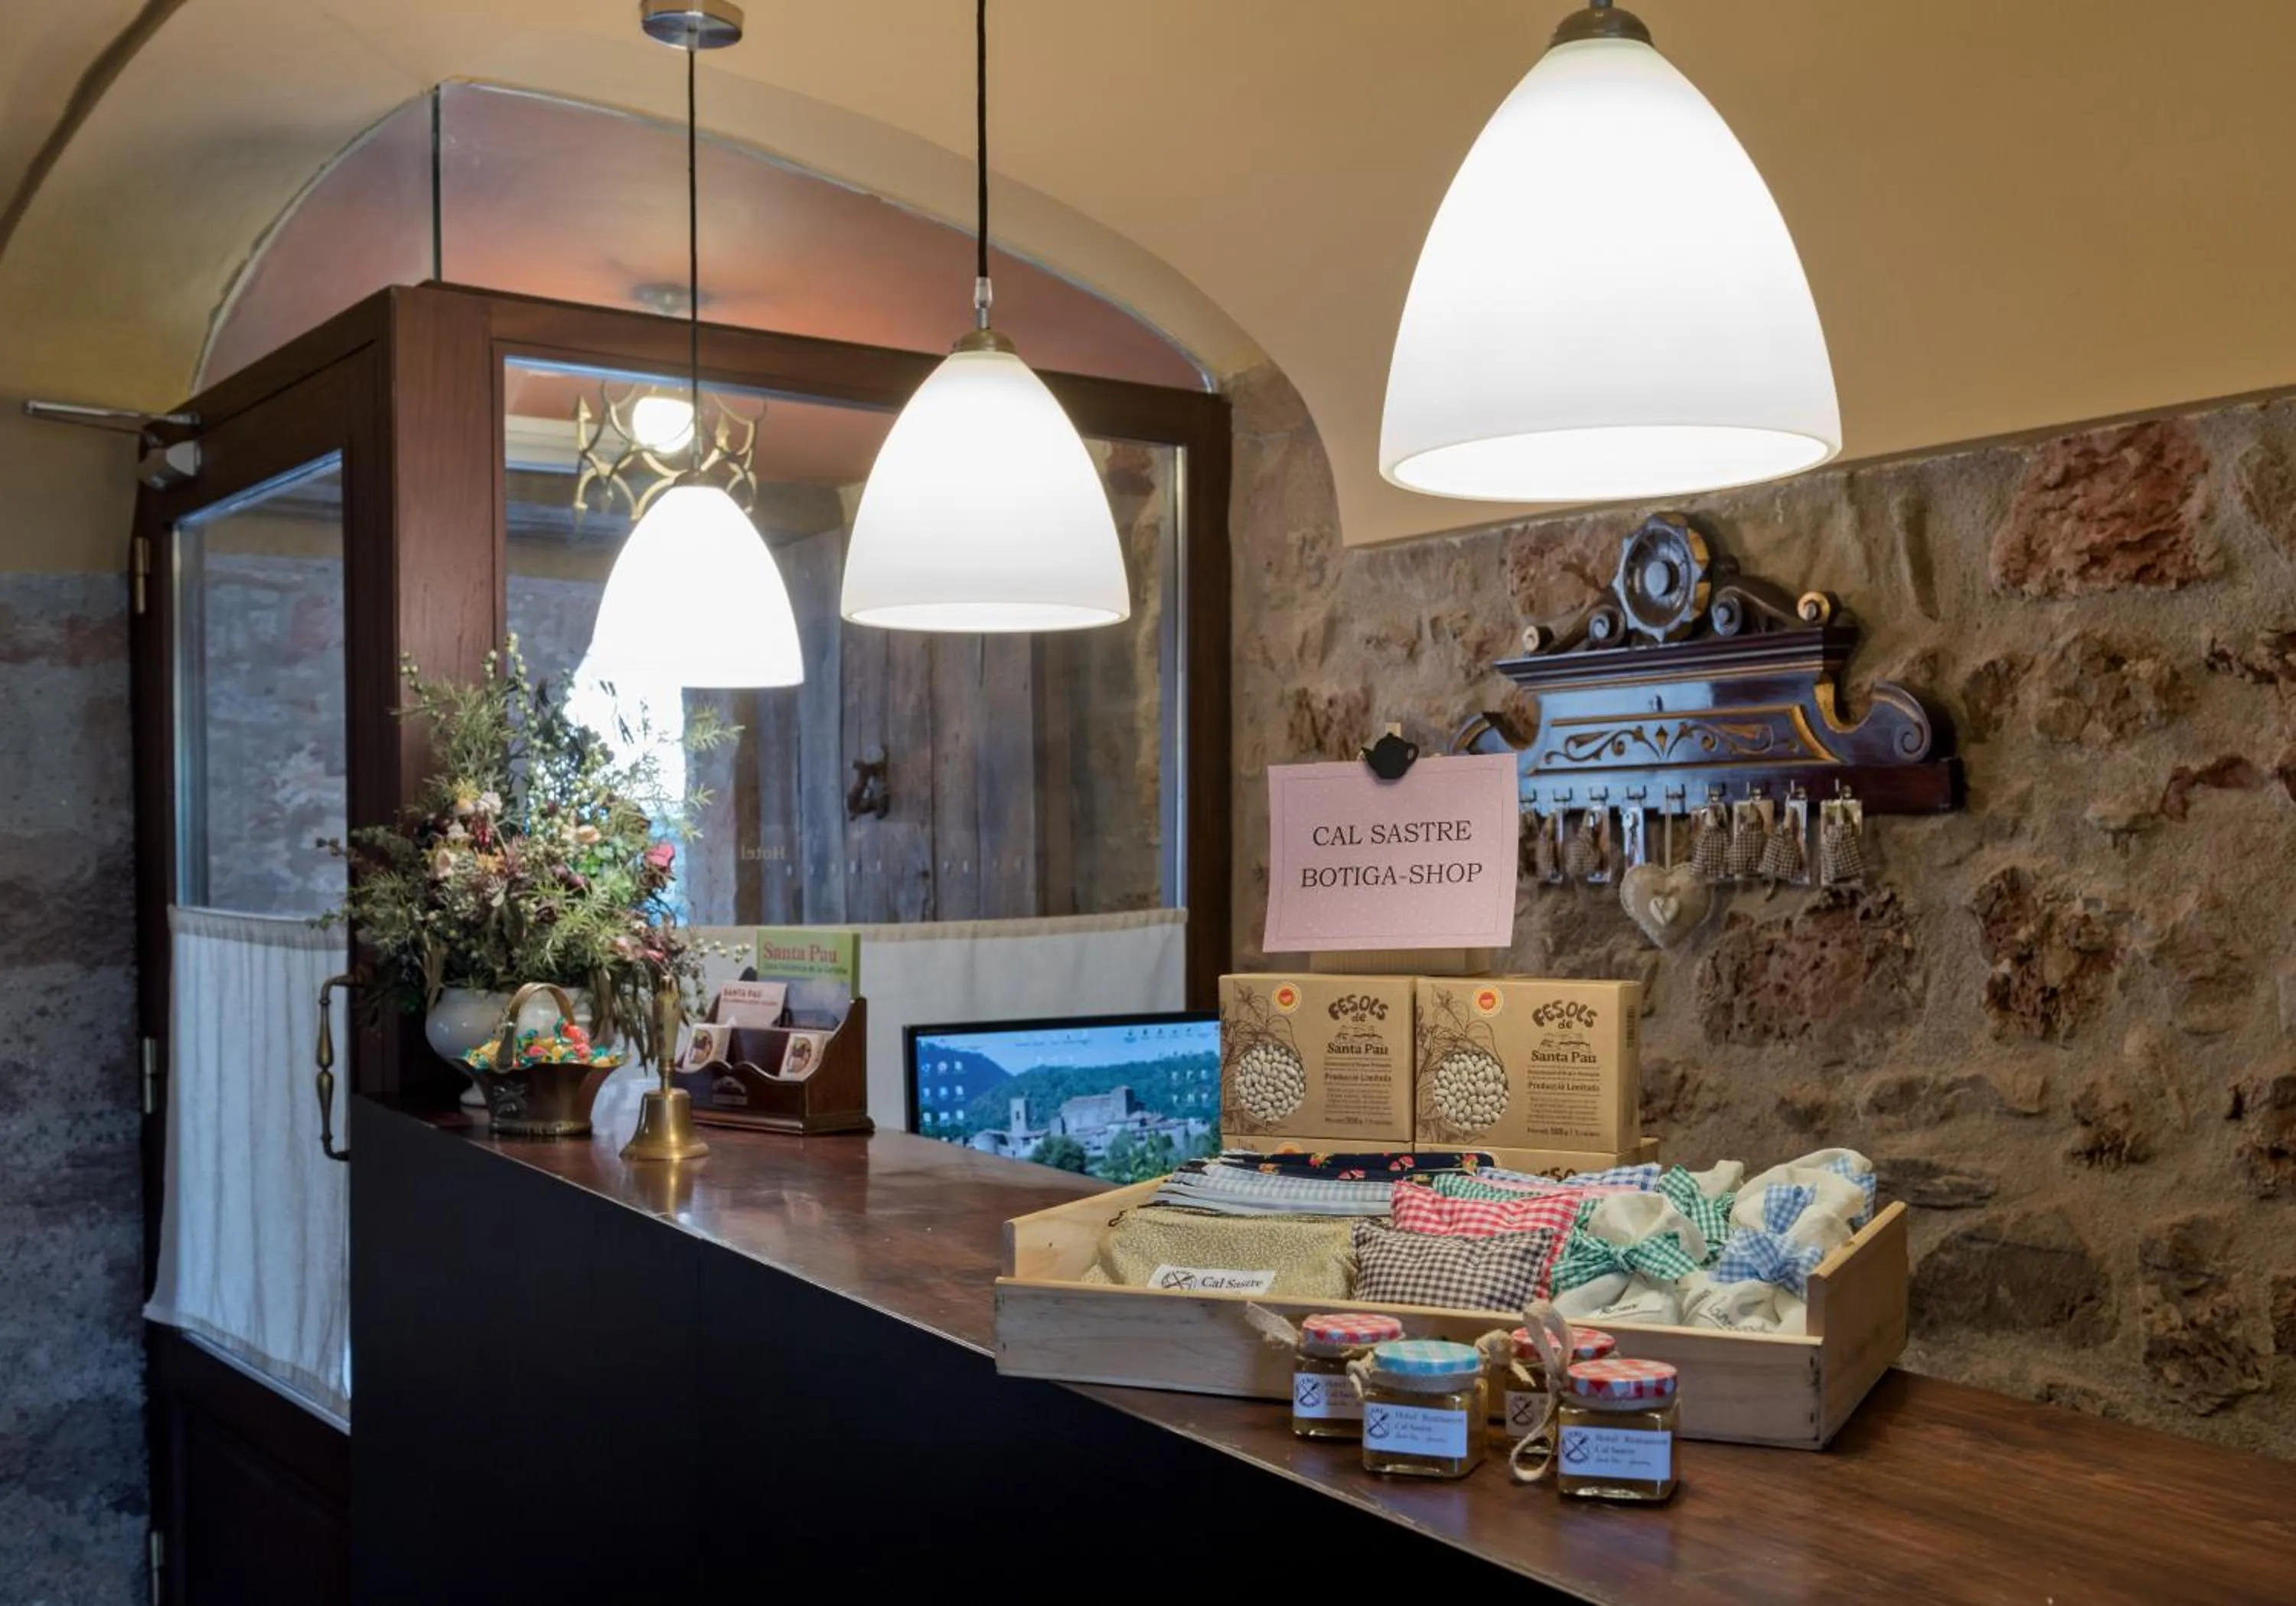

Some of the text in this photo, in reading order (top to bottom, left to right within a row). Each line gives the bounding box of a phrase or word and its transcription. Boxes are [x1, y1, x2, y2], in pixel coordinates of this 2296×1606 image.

[1313, 820, 1473, 846] CAL SASTRE
[1301, 863, 1482, 887] BOTIGA-SHOP
[763, 941, 838, 963] Santa Pau
[1352, 1013, 1366, 1022] de
[1557, 1019, 1573, 1029] de
[1327, 1043, 1389, 1055] Santa Pau
[1531, 1049, 1597, 1063] Santa Pau
[1201, 1276, 1264, 1288] Cal Sastre
